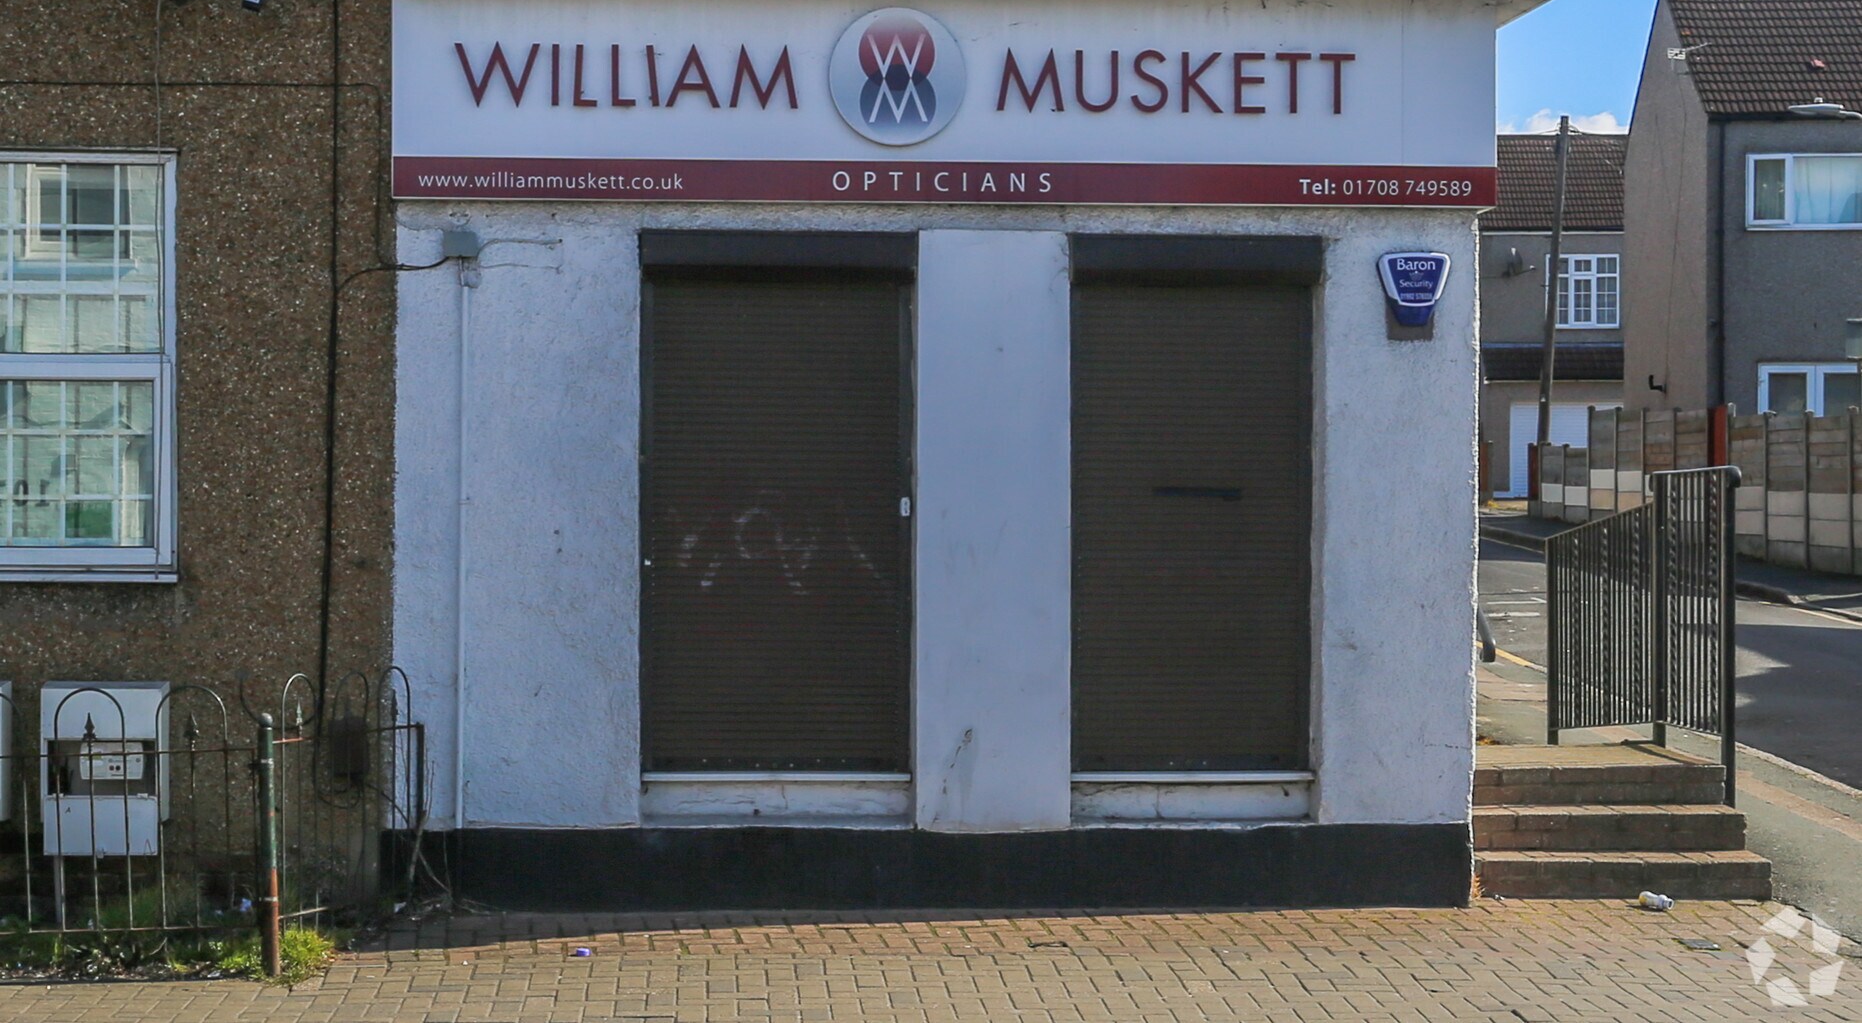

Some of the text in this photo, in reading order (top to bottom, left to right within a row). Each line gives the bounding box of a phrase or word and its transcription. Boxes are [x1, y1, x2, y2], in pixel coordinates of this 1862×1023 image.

[867, 33, 927, 79] W
[454, 41, 1357, 115] WILLIAM MUSKETT
[868, 77, 929, 123] M
[418, 171, 684, 191] www.williammuskett.co.uk
[831, 170, 1052, 193] OPTICIANS
[1299, 178, 1472, 197] Tel: 01708 749589
[1396, 258, 1436, 271] Baron
[1399, 278, 1434, 290] Security
